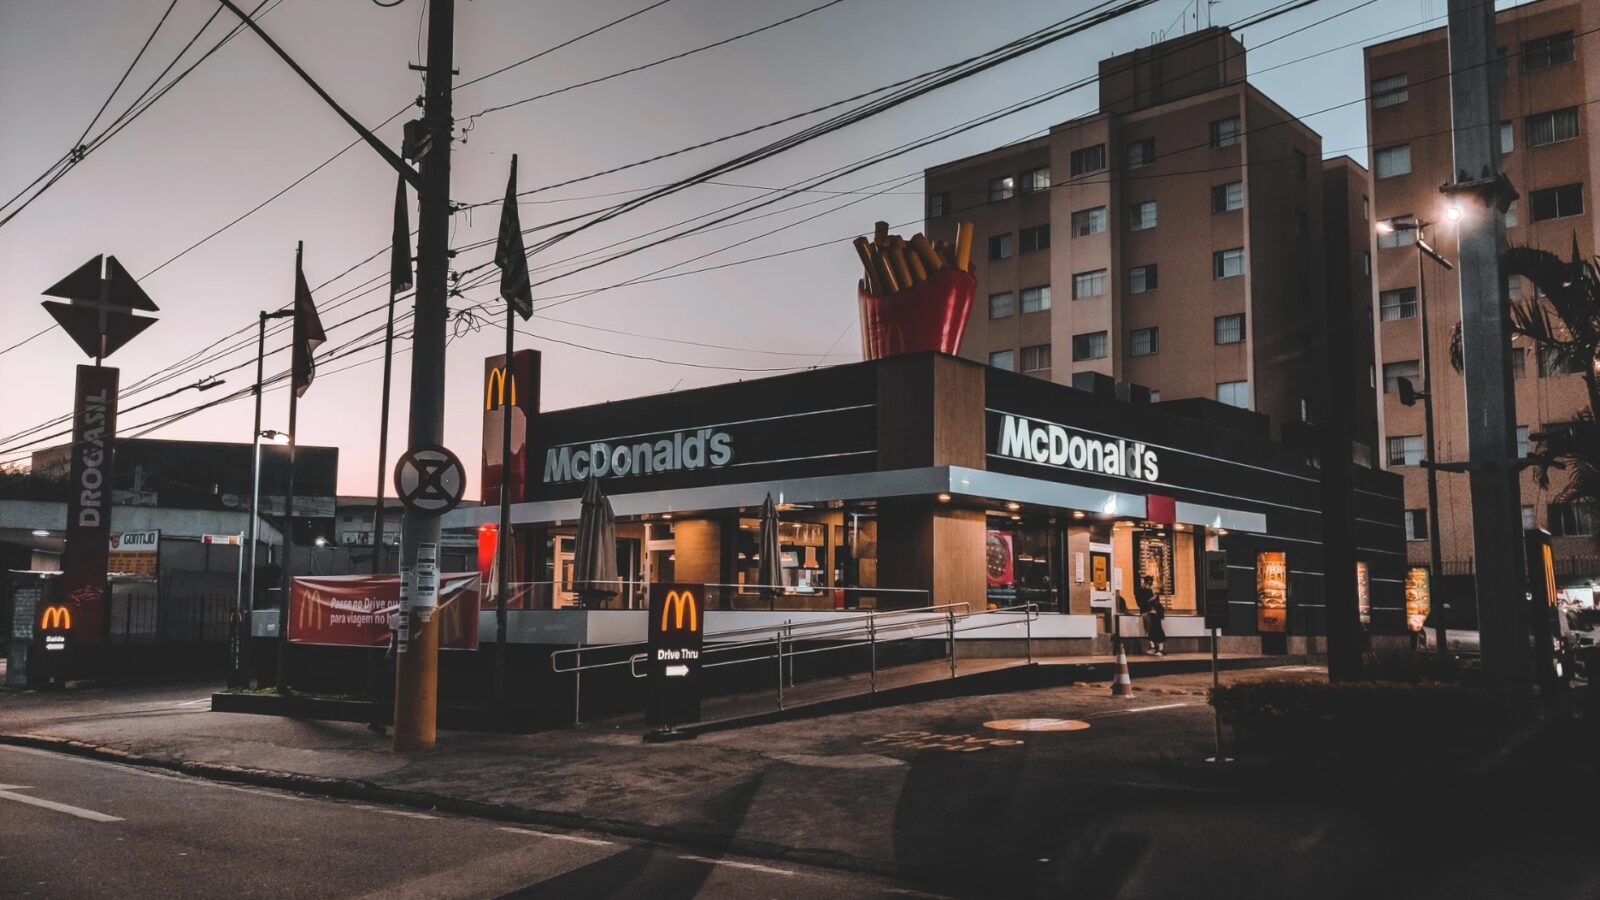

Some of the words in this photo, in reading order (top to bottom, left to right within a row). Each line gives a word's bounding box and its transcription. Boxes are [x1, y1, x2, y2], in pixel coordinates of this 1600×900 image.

[80, 388, 107, 527] DROGASIL
[543, 428, 732, 483] McDonald's
[1001, 415, 1159, 482] McDonald's
[330, 614, 346, 627] para
[347, 612, 373, 627] viagem
[374, 614, 385, 624] no
[353, 600, 363, 609] no
[364, 597, 385, 610] Drive
[657, 649, 680, 660] Drive
[681, 648, 698, 659] Thru
